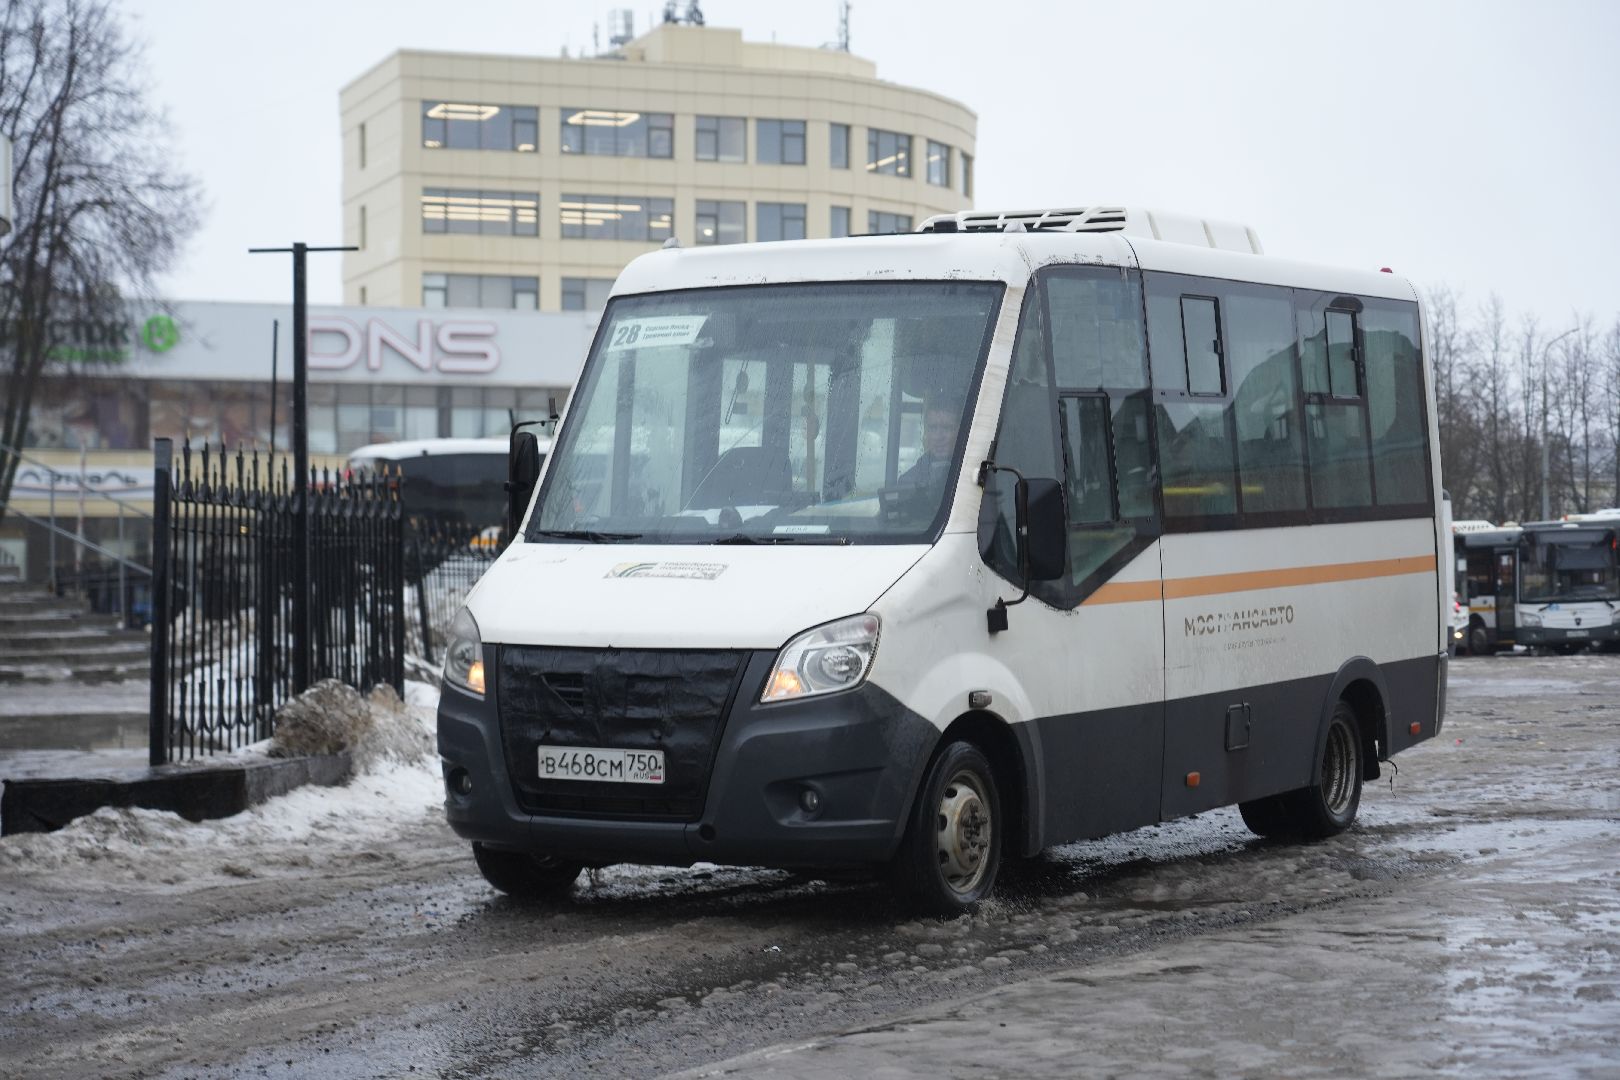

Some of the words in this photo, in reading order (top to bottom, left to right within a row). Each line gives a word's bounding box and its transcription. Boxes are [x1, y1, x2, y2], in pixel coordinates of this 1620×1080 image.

[307, 316, 499, 374] DNS
[614, 325, 641, 346] 28
[1184, 604, 1294, 637] МОСТАНСАВТО
[545, 752, 623, 777] В468СМ
[626, 753, 658, 771] 750
[633, 772, 649, 780] RUS
